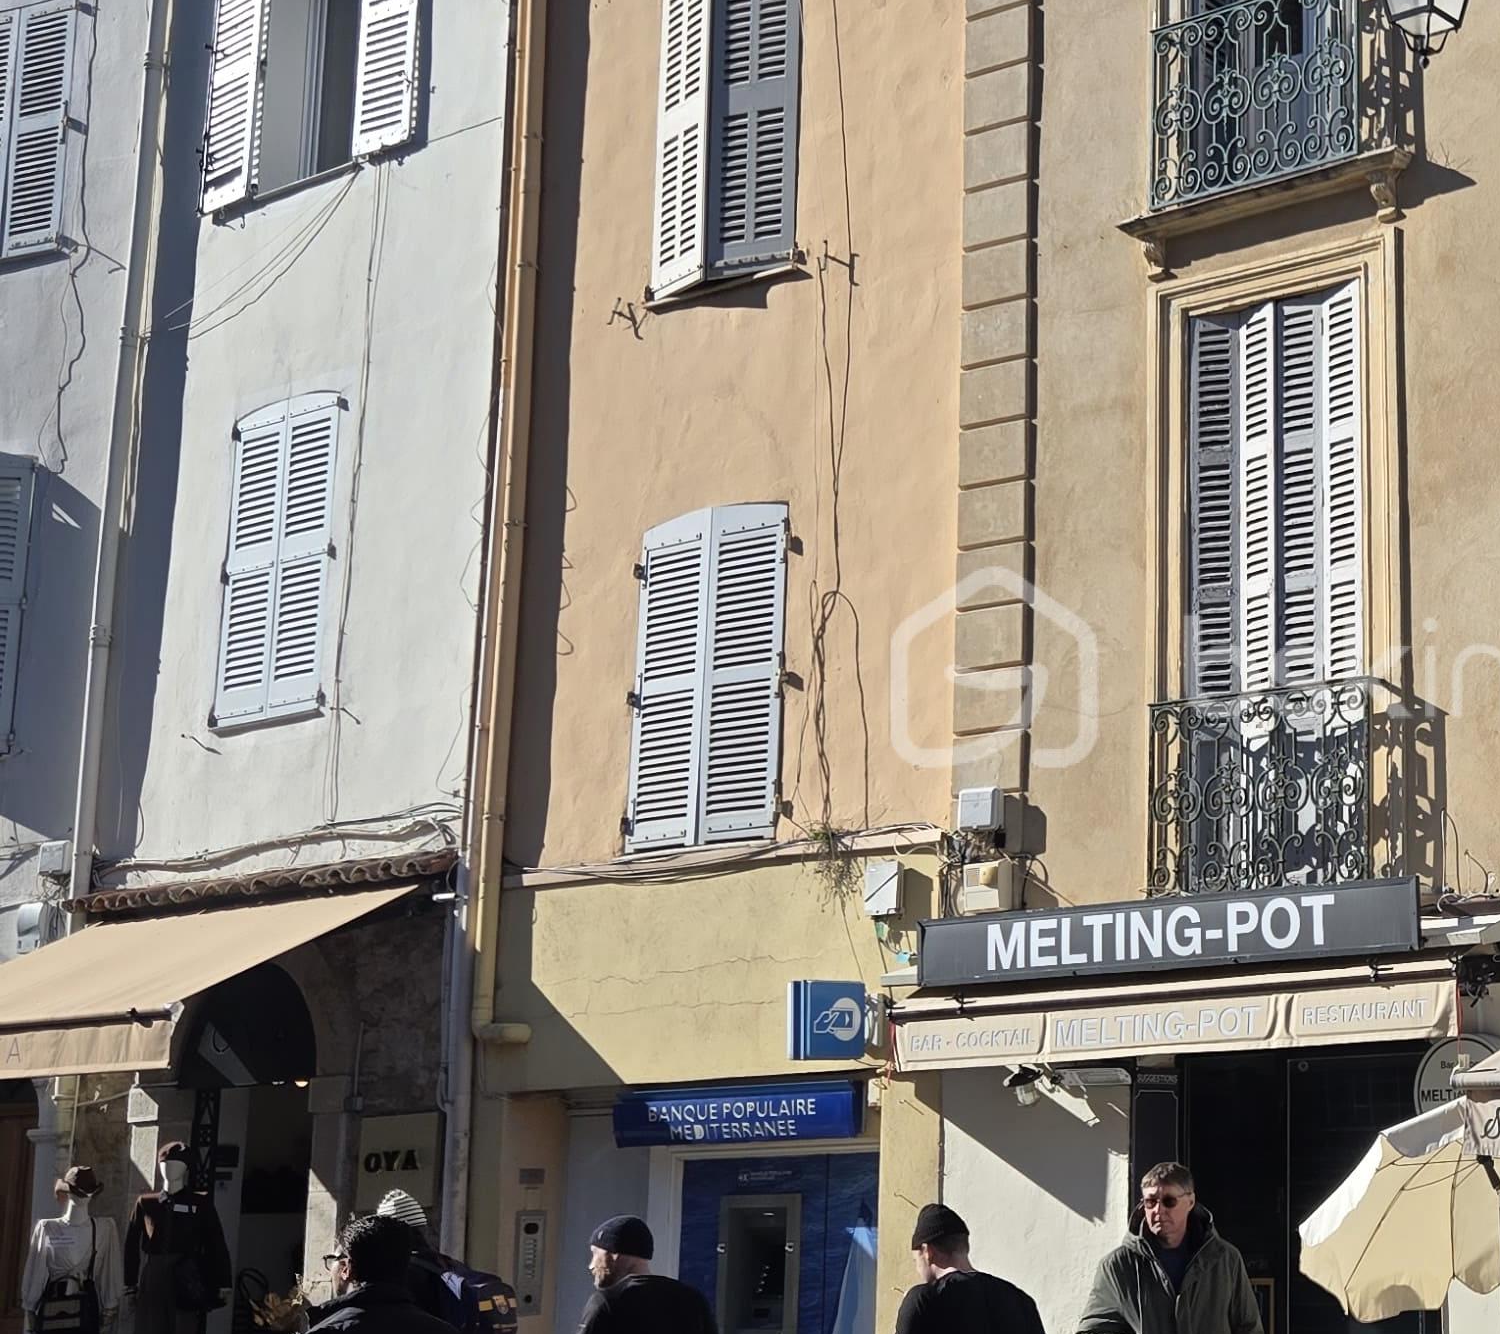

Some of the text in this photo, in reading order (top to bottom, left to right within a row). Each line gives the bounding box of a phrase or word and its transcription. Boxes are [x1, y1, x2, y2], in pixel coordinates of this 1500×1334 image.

[986, 894, 1335, 971] MELTING-POT
[1301, 997, 1429, 1026] RESTAURANT
[910, 1033, 943, 1052] BAR
[956, 1026, 1036, 1048] COCKTAIL
[1054, 1005, 1261, 1048] MELTING-POT
[648, 1097, 816, 1122] BANQUE POPULAIRE
[364, 1149, 419, 1173] OYA
